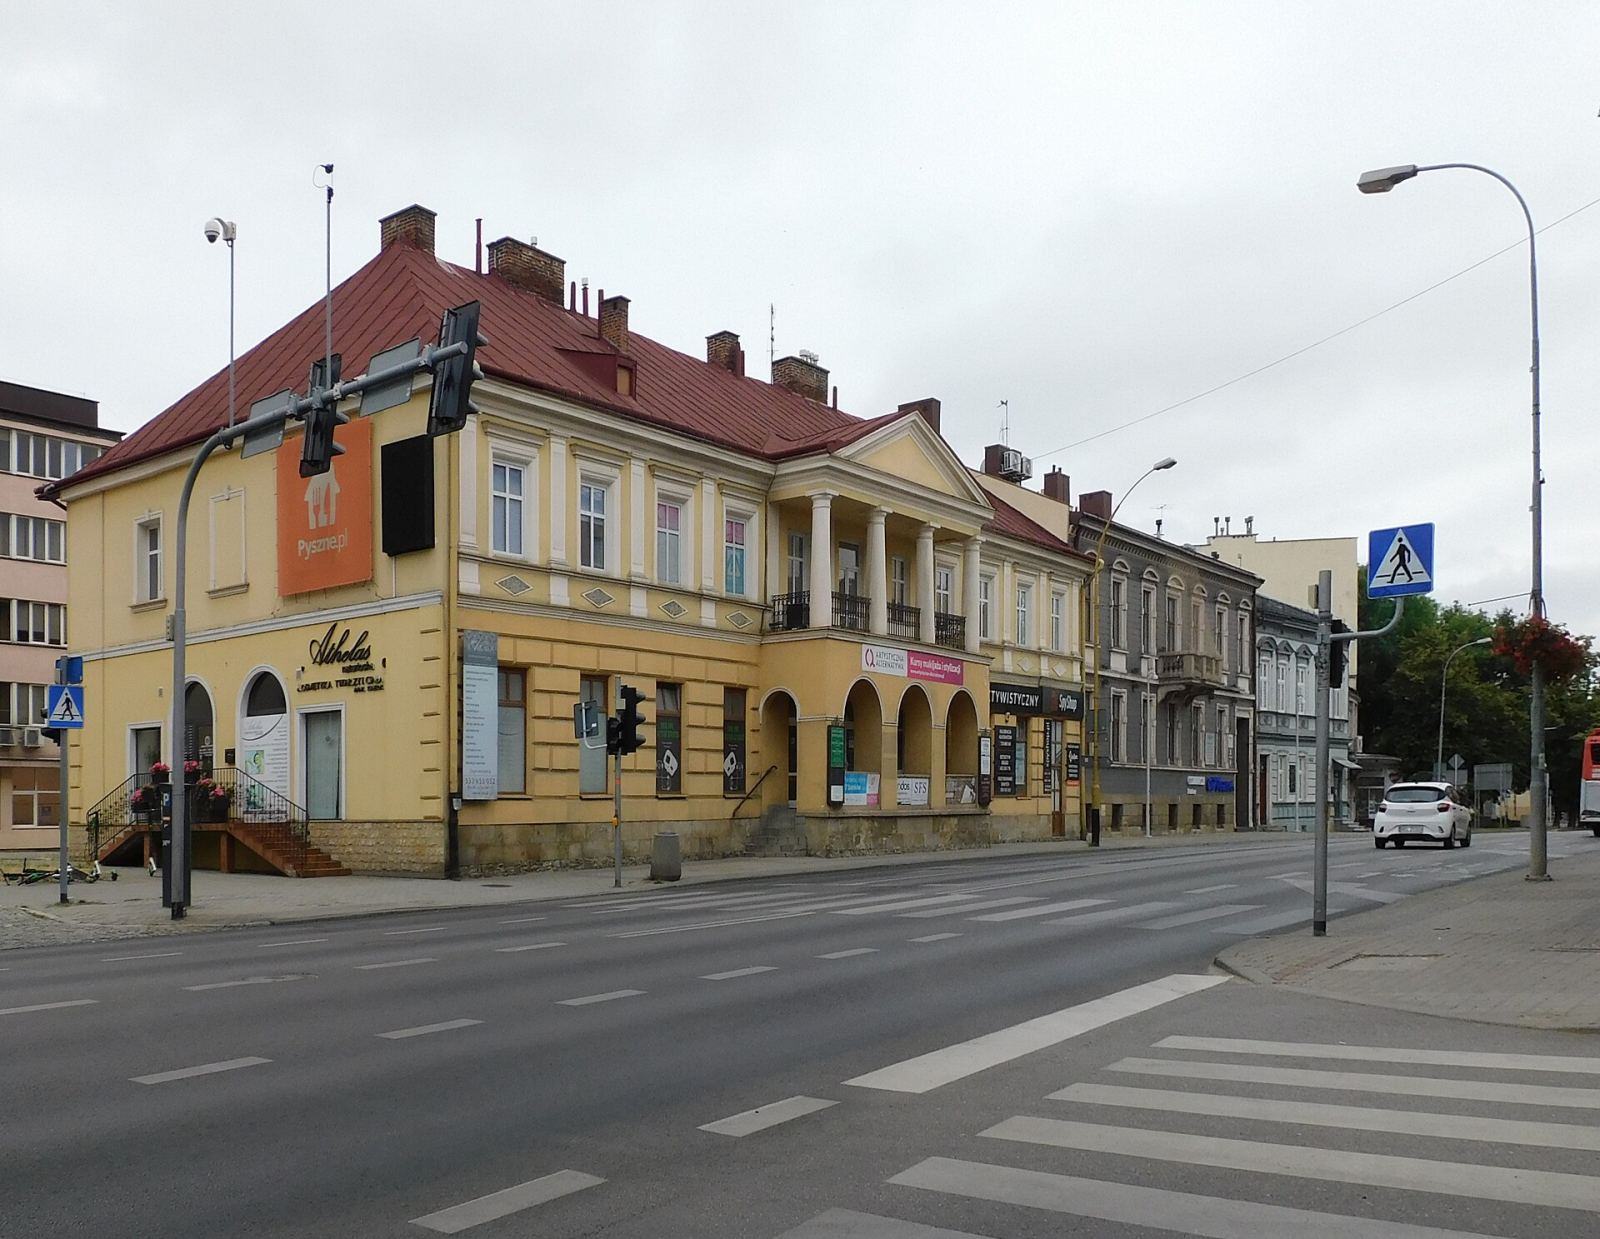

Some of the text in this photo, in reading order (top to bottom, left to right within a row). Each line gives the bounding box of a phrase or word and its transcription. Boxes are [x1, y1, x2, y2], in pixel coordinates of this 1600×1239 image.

[298, 528, 348, 560] Pyszne.pl
[309, 622, 371, 666] Athelas
[991, 690, 1039, 707] TYWISTYCZNY
[914, 781, 927, 794] SFS
[163, 793, 170, 806] P
